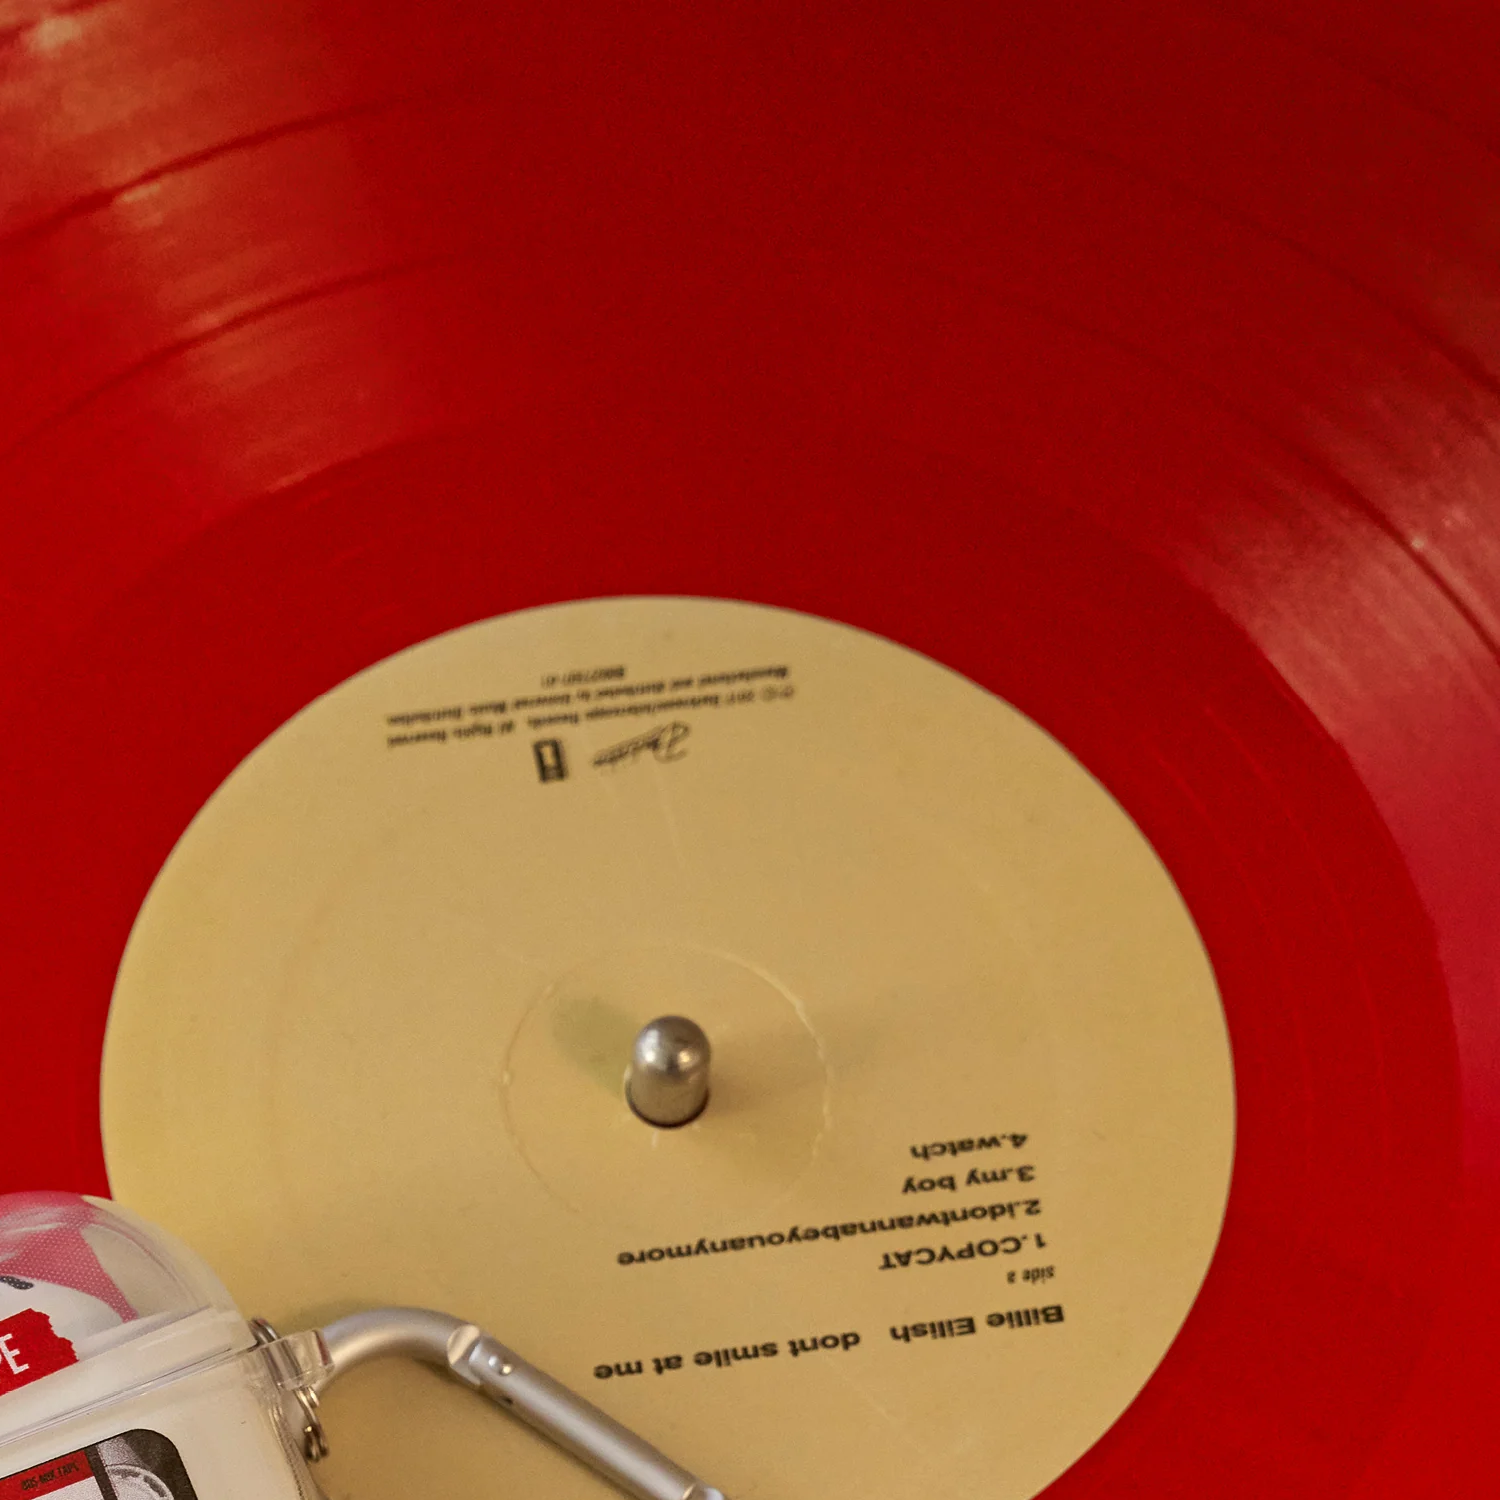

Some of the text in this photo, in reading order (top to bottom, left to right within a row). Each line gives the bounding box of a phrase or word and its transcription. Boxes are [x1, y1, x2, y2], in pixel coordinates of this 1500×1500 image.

[910, 1132, 1028, 1160] 4.watch
[902, 1164, 1036, 1195] 3.my boy
[617, 1199, 1042, 1266] 2.idontwannabeyouanymore
[878, 1232, 1047, 1270] 1.COPYCAT
[1022, 1265, 1056, 1282] side
[593, 1304, 1065, 1381] Billie Eilish dont smile at me
